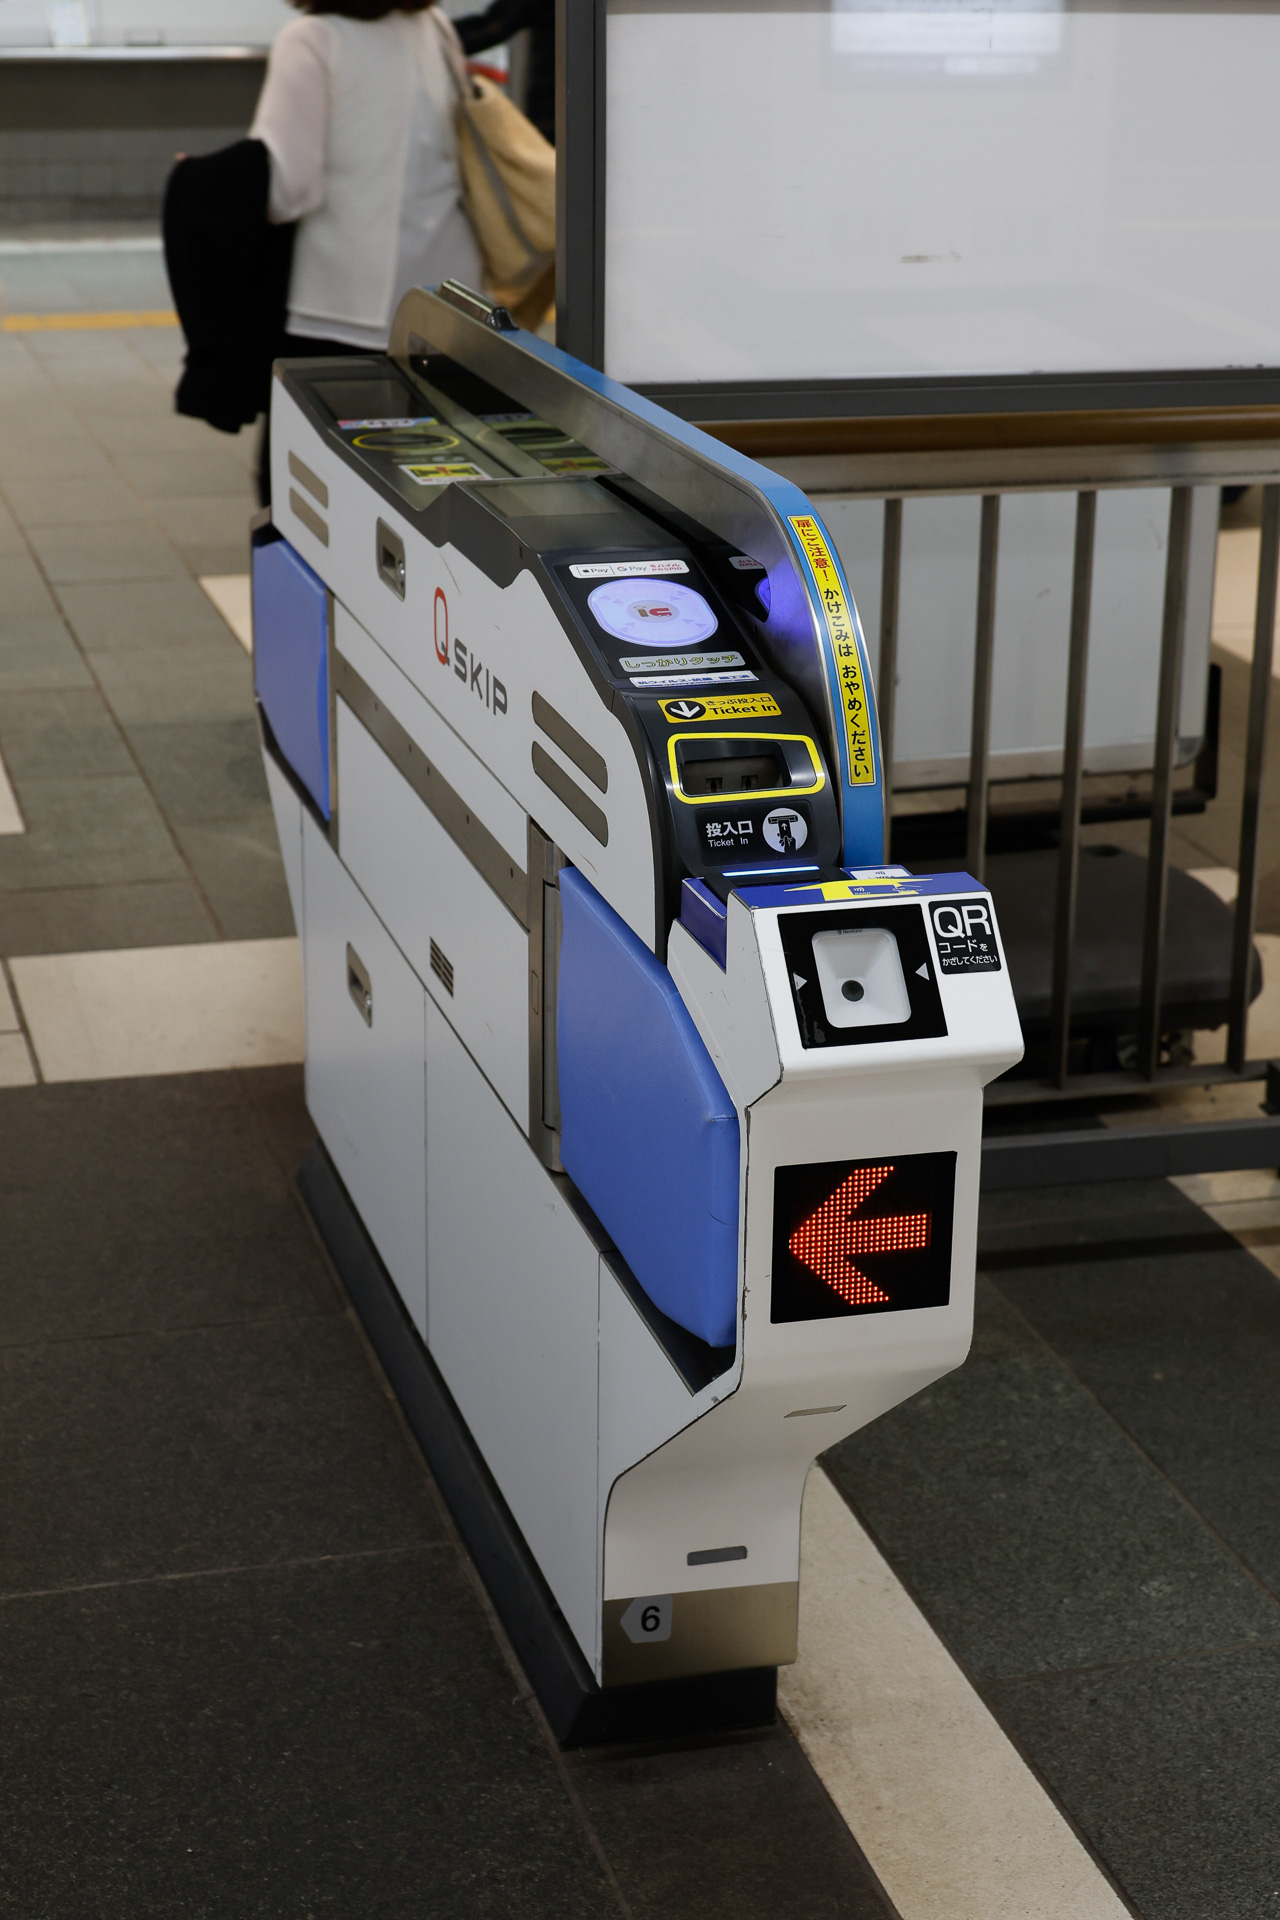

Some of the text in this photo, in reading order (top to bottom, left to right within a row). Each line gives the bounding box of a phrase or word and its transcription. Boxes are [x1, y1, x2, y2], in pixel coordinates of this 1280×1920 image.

[824, 588, 853, 657] かけこみは
[842, 665, 869, 777] おやめください
[709, 705, 758, 715] Ticket
[706, 821, 753, 837] 投入口
[708, 837, 749, 847] Ticket In
[933, 905, 992, 938] QR
[942, 955, 998, 966] かざしてください
[641, 1605, 661, 1632] 6
